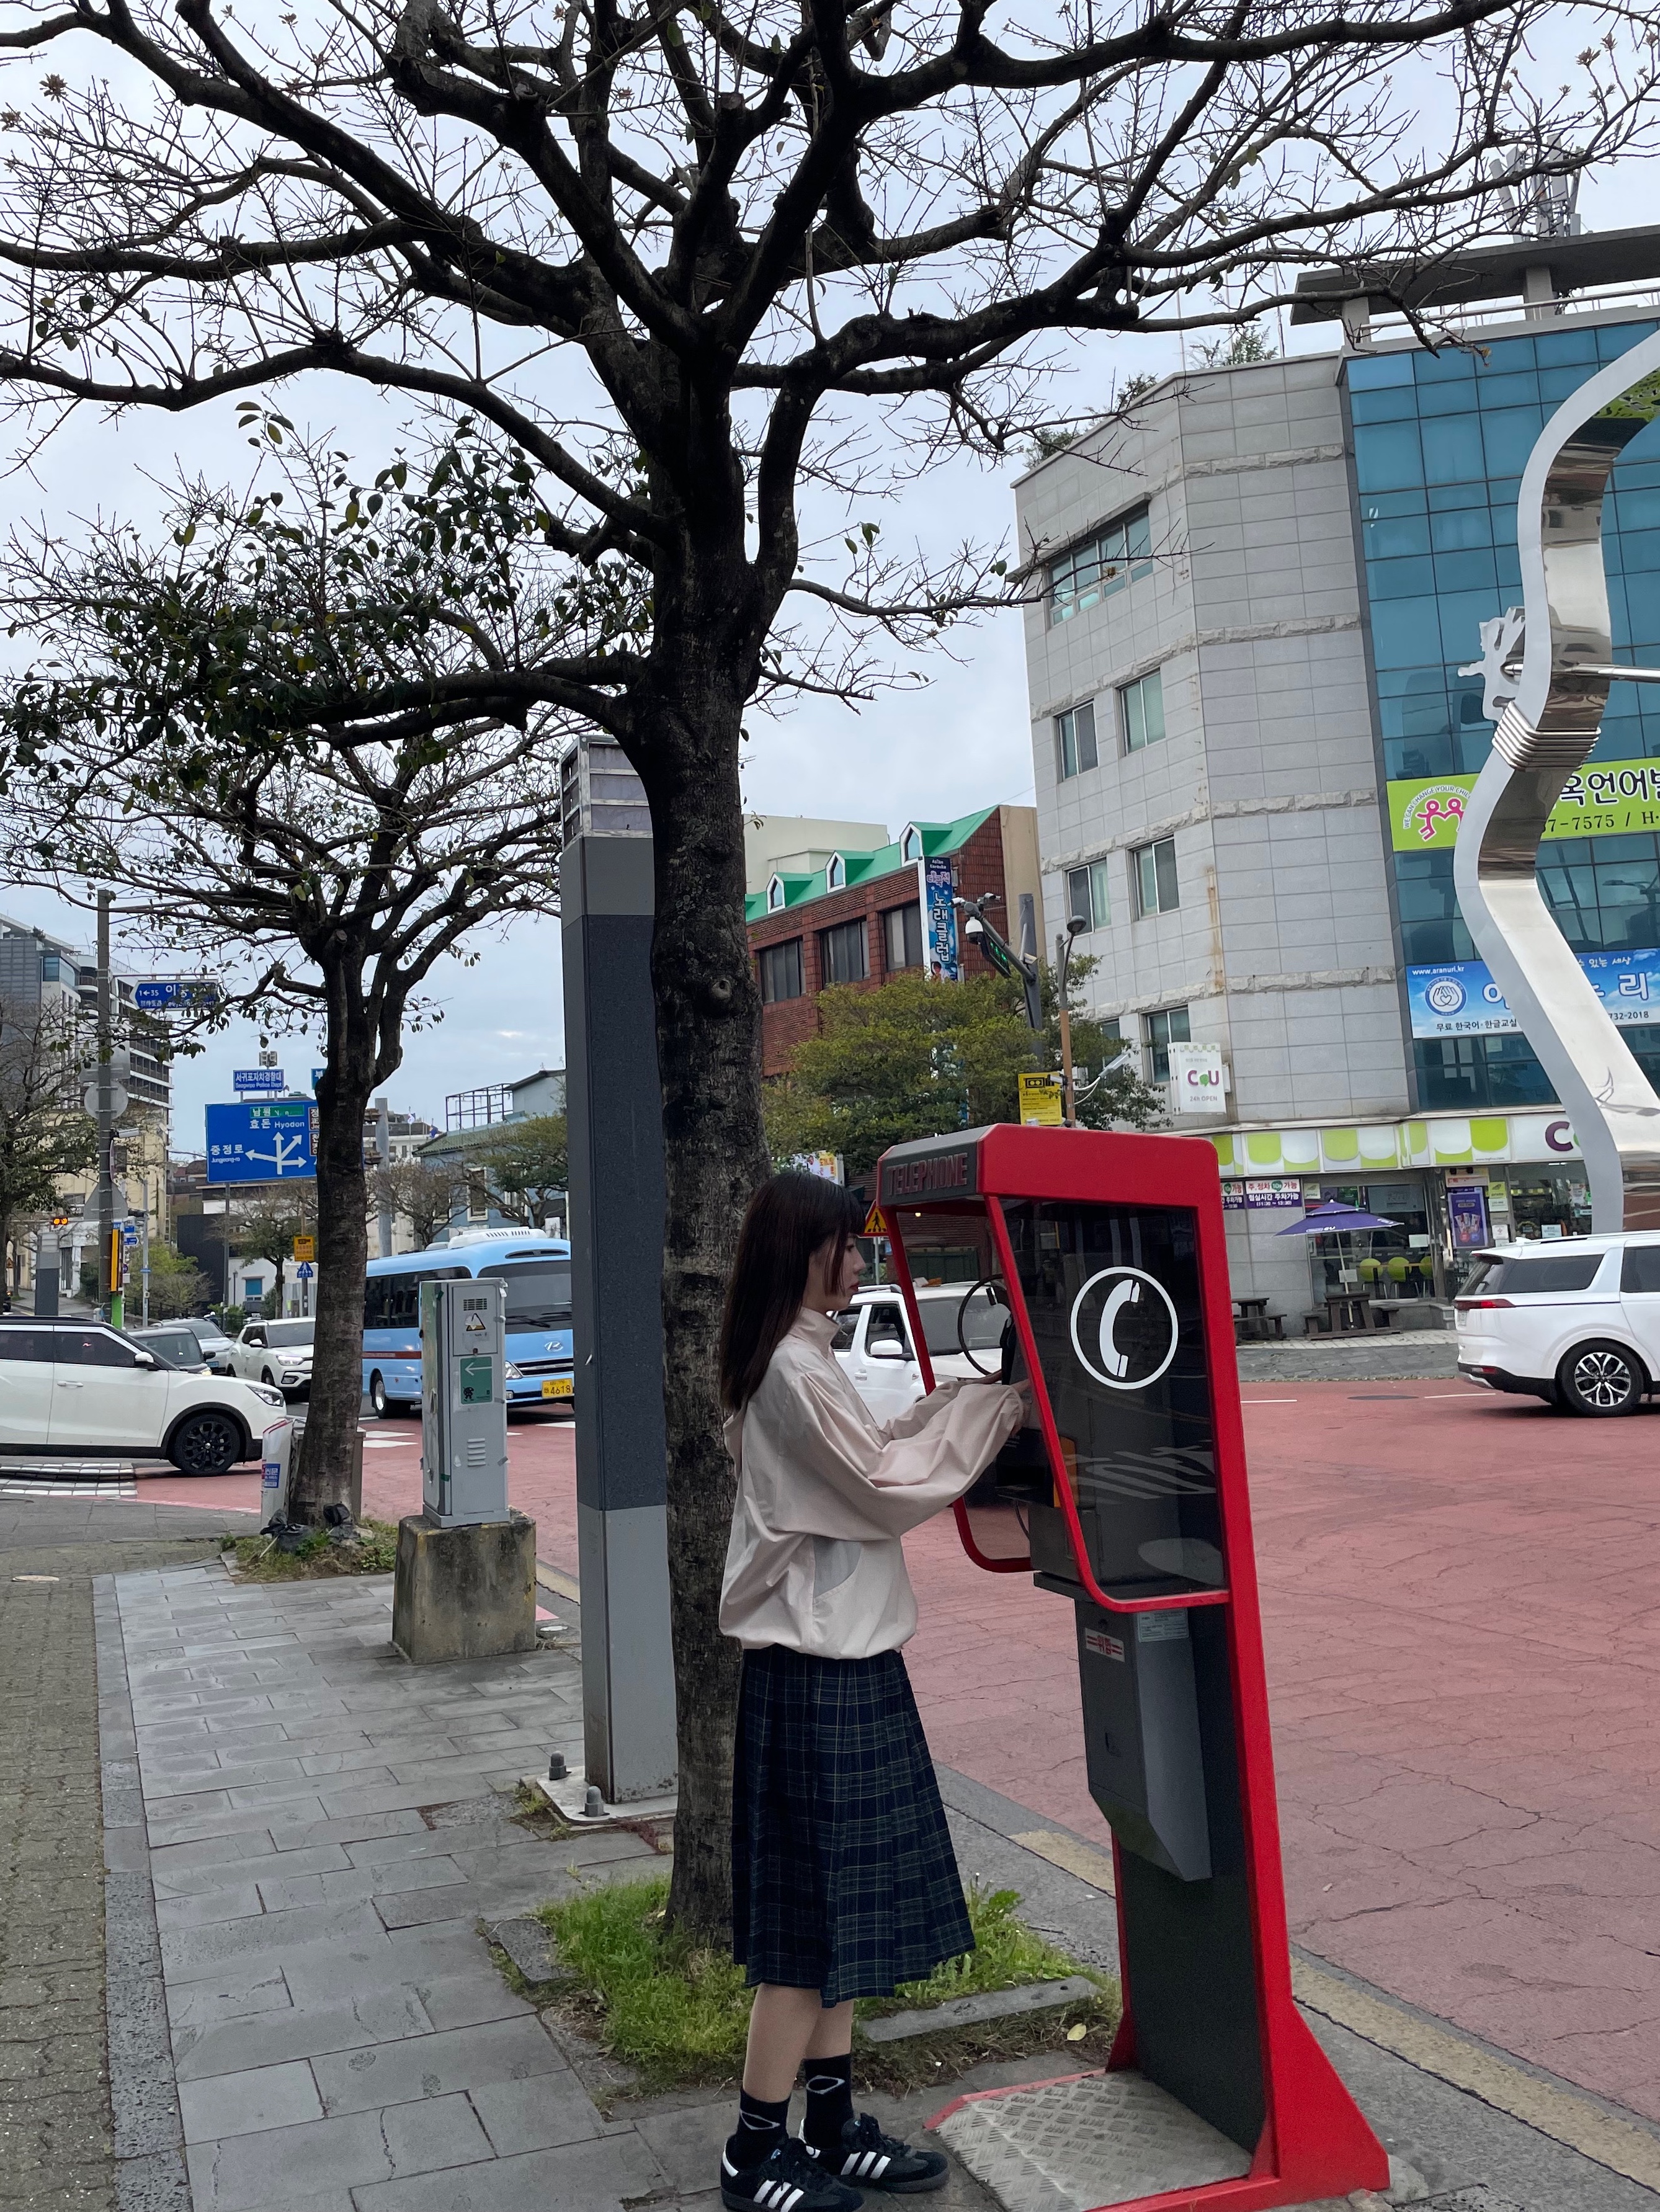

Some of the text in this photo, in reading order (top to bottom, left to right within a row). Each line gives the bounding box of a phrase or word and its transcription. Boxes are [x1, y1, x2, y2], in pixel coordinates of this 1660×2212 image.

[1412, 788, 1435, 806] CHANGE
[1405, 805, 1415, 817] CAN
[1404, 819, 1411, 828] WE
[1547, 814, 1615, 832] 7-7575
[934, 892, 950, 962] 노래클럽
[1589, 957, 1607, 968] 있는
[1612, 957, 1631, 965] 세상
[1412, 965, 1465, 975] www.aranuri.kr
[1436, 1023, 1453, 1032] 무료
[236, 1071, 282, 1082] 서귀포자치경찰대
[252, 1107, 271, 1117] 남원
[249, 1118, 272, 1129] 효돈
[274, 1121, 305, 1130] Hyodon
[210, 1144, 244, 1156] 중정로
[886, 1153, 968, 1196] TELEPHONE
[1283, 1182, 1298, 1190] 가능
[1248, 1192, 1299, 1202] 점심시간 주차가능
